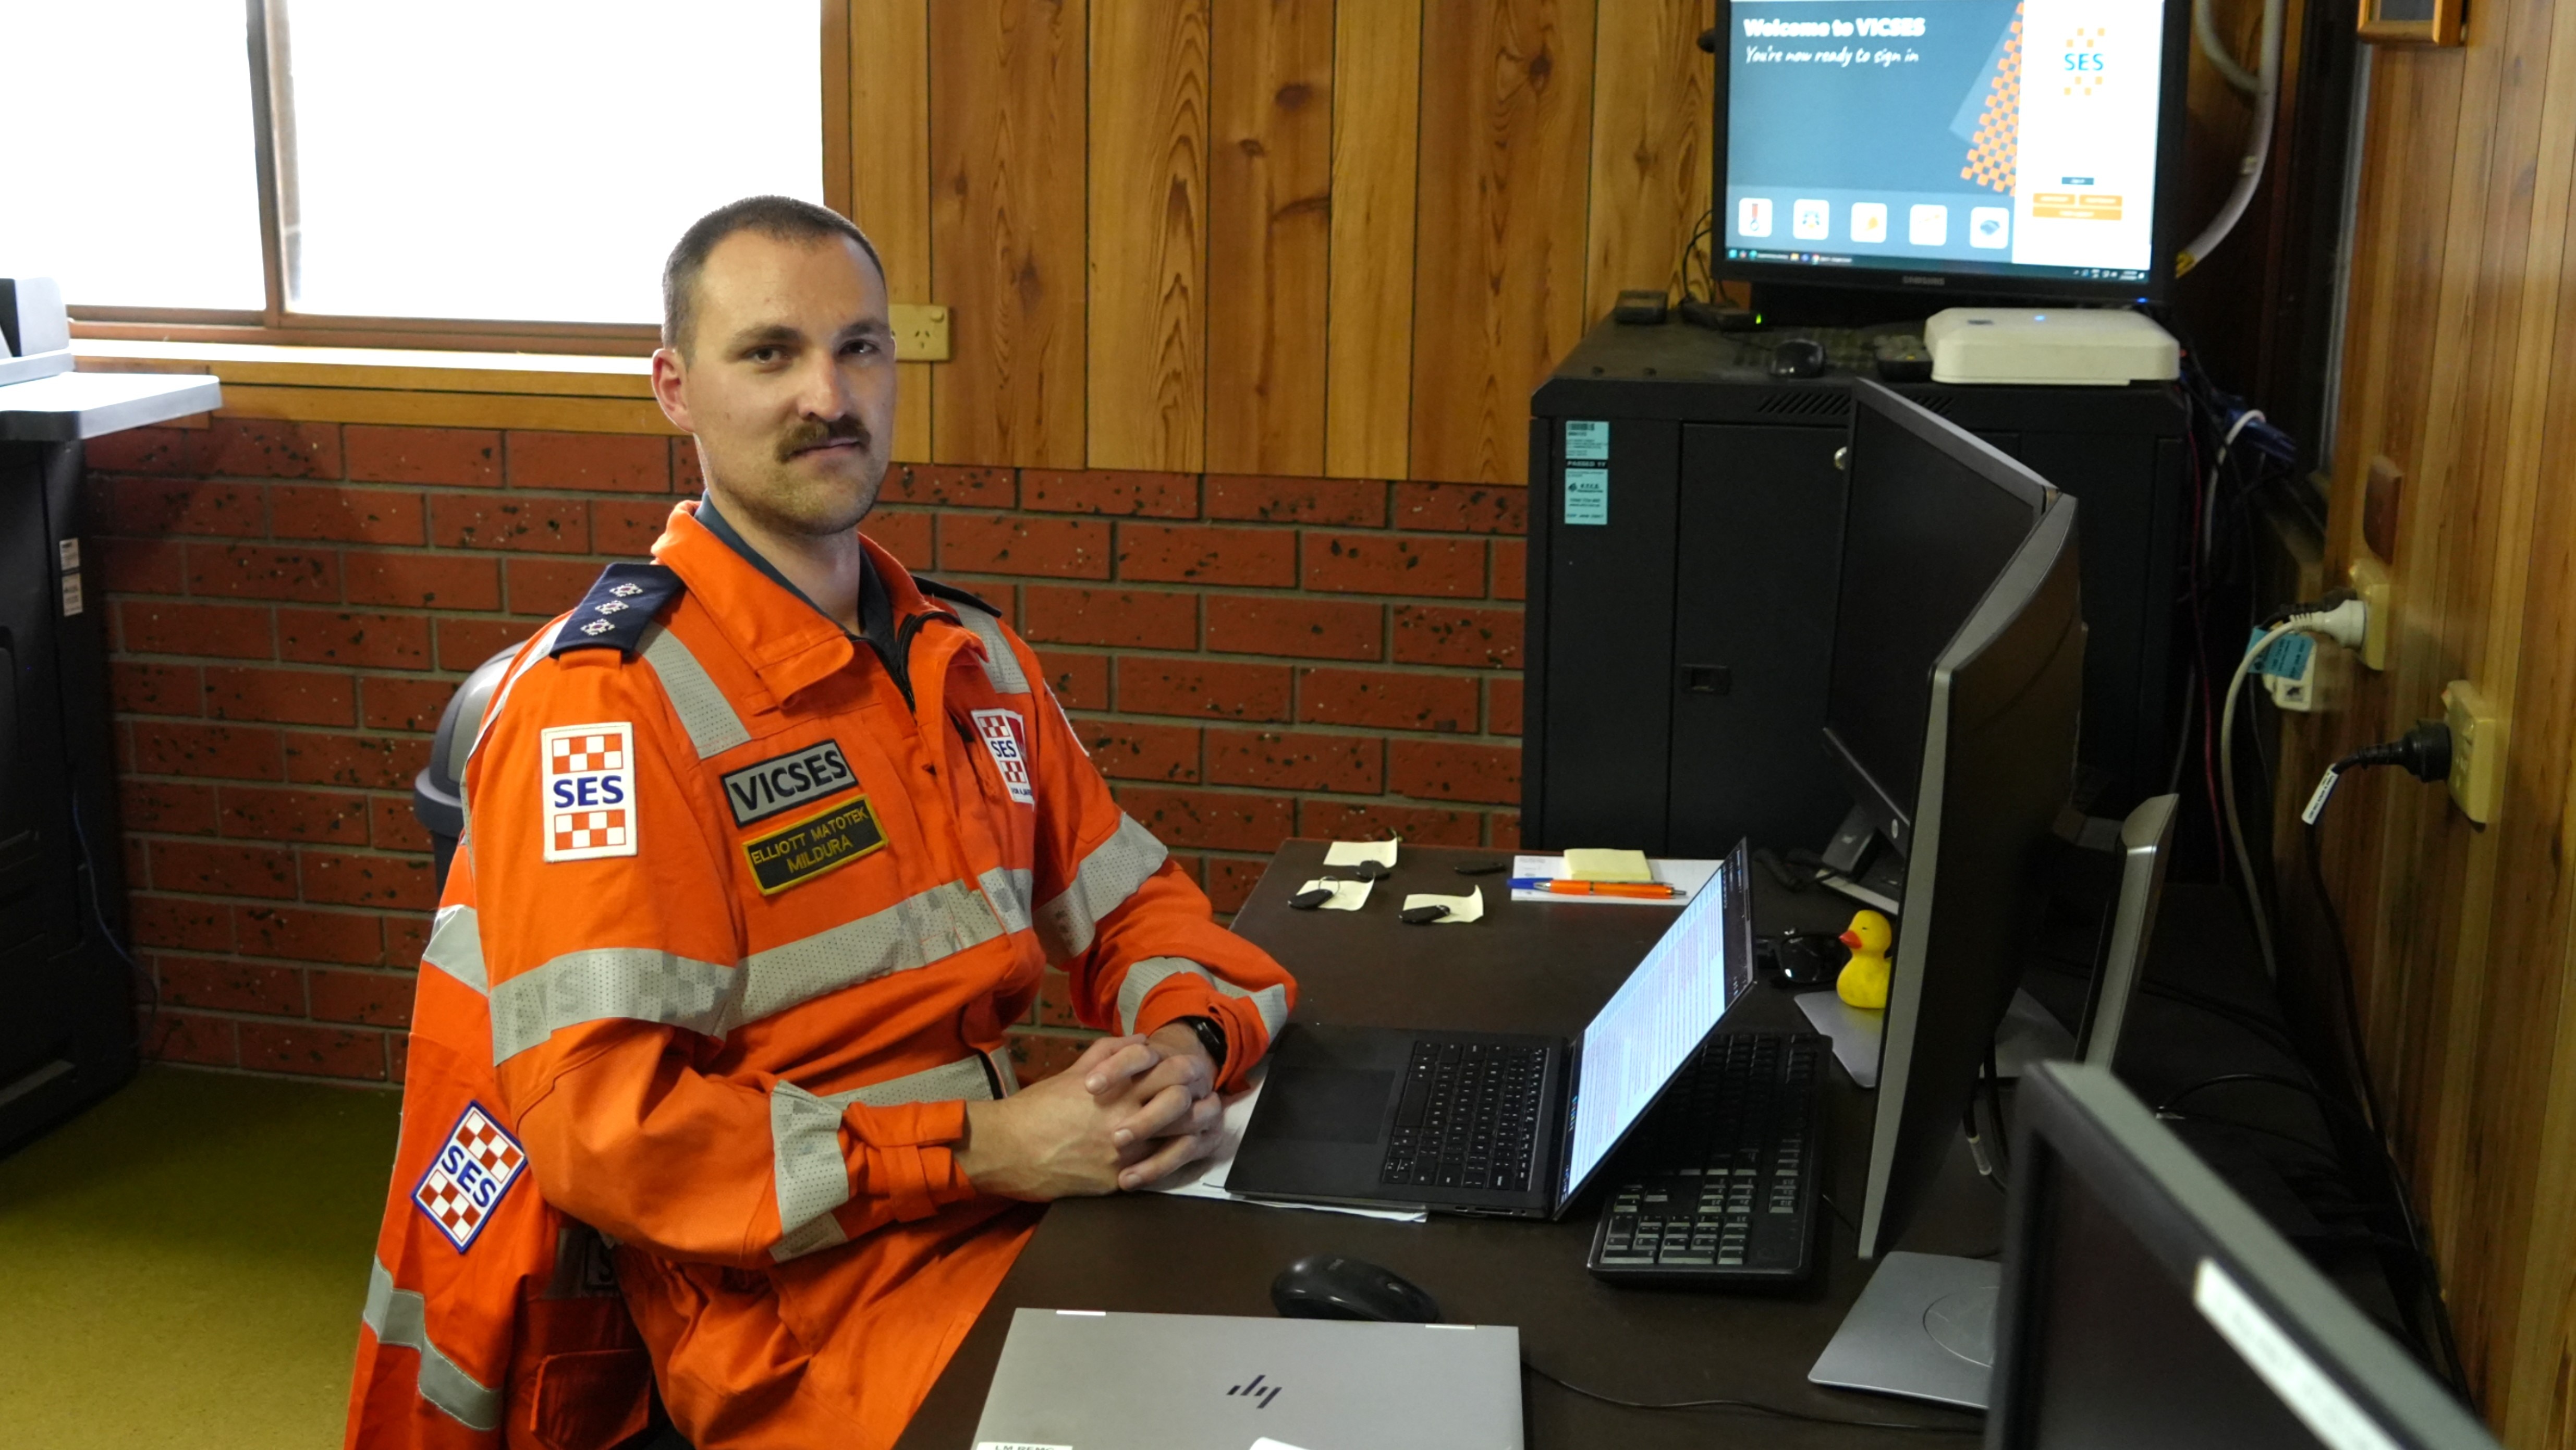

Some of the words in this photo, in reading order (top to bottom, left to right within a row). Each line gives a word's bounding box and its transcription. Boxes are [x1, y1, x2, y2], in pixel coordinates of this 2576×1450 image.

[1743, 18, 1830, 37] Welcome
[1832, 19, 1854, 36] to
[1856, 17, 1925, 36] VICSES
[1747, 45, 1783, 64] You're
[1785, 51, 1812, 62] now
[1814, 45, 1852, 67] ready
[1855, 47, 1870, 63] to
[1874, 47, 1901, 67] sign
[1904, 48, 1919, 62] in
[2065, 53, 2104, 71] SES
[991, 740, 1017, 758] SES
[553, 775, 624, 808] SES
[730, 750, 847, 811] VICSES
[751, 832, 805, 864] ELLIOTT
[811, 806, 868, 841] MATOTEK
[786, 834, 853, 874] MILDURA
[441, 1145, 497, 1208] SES
